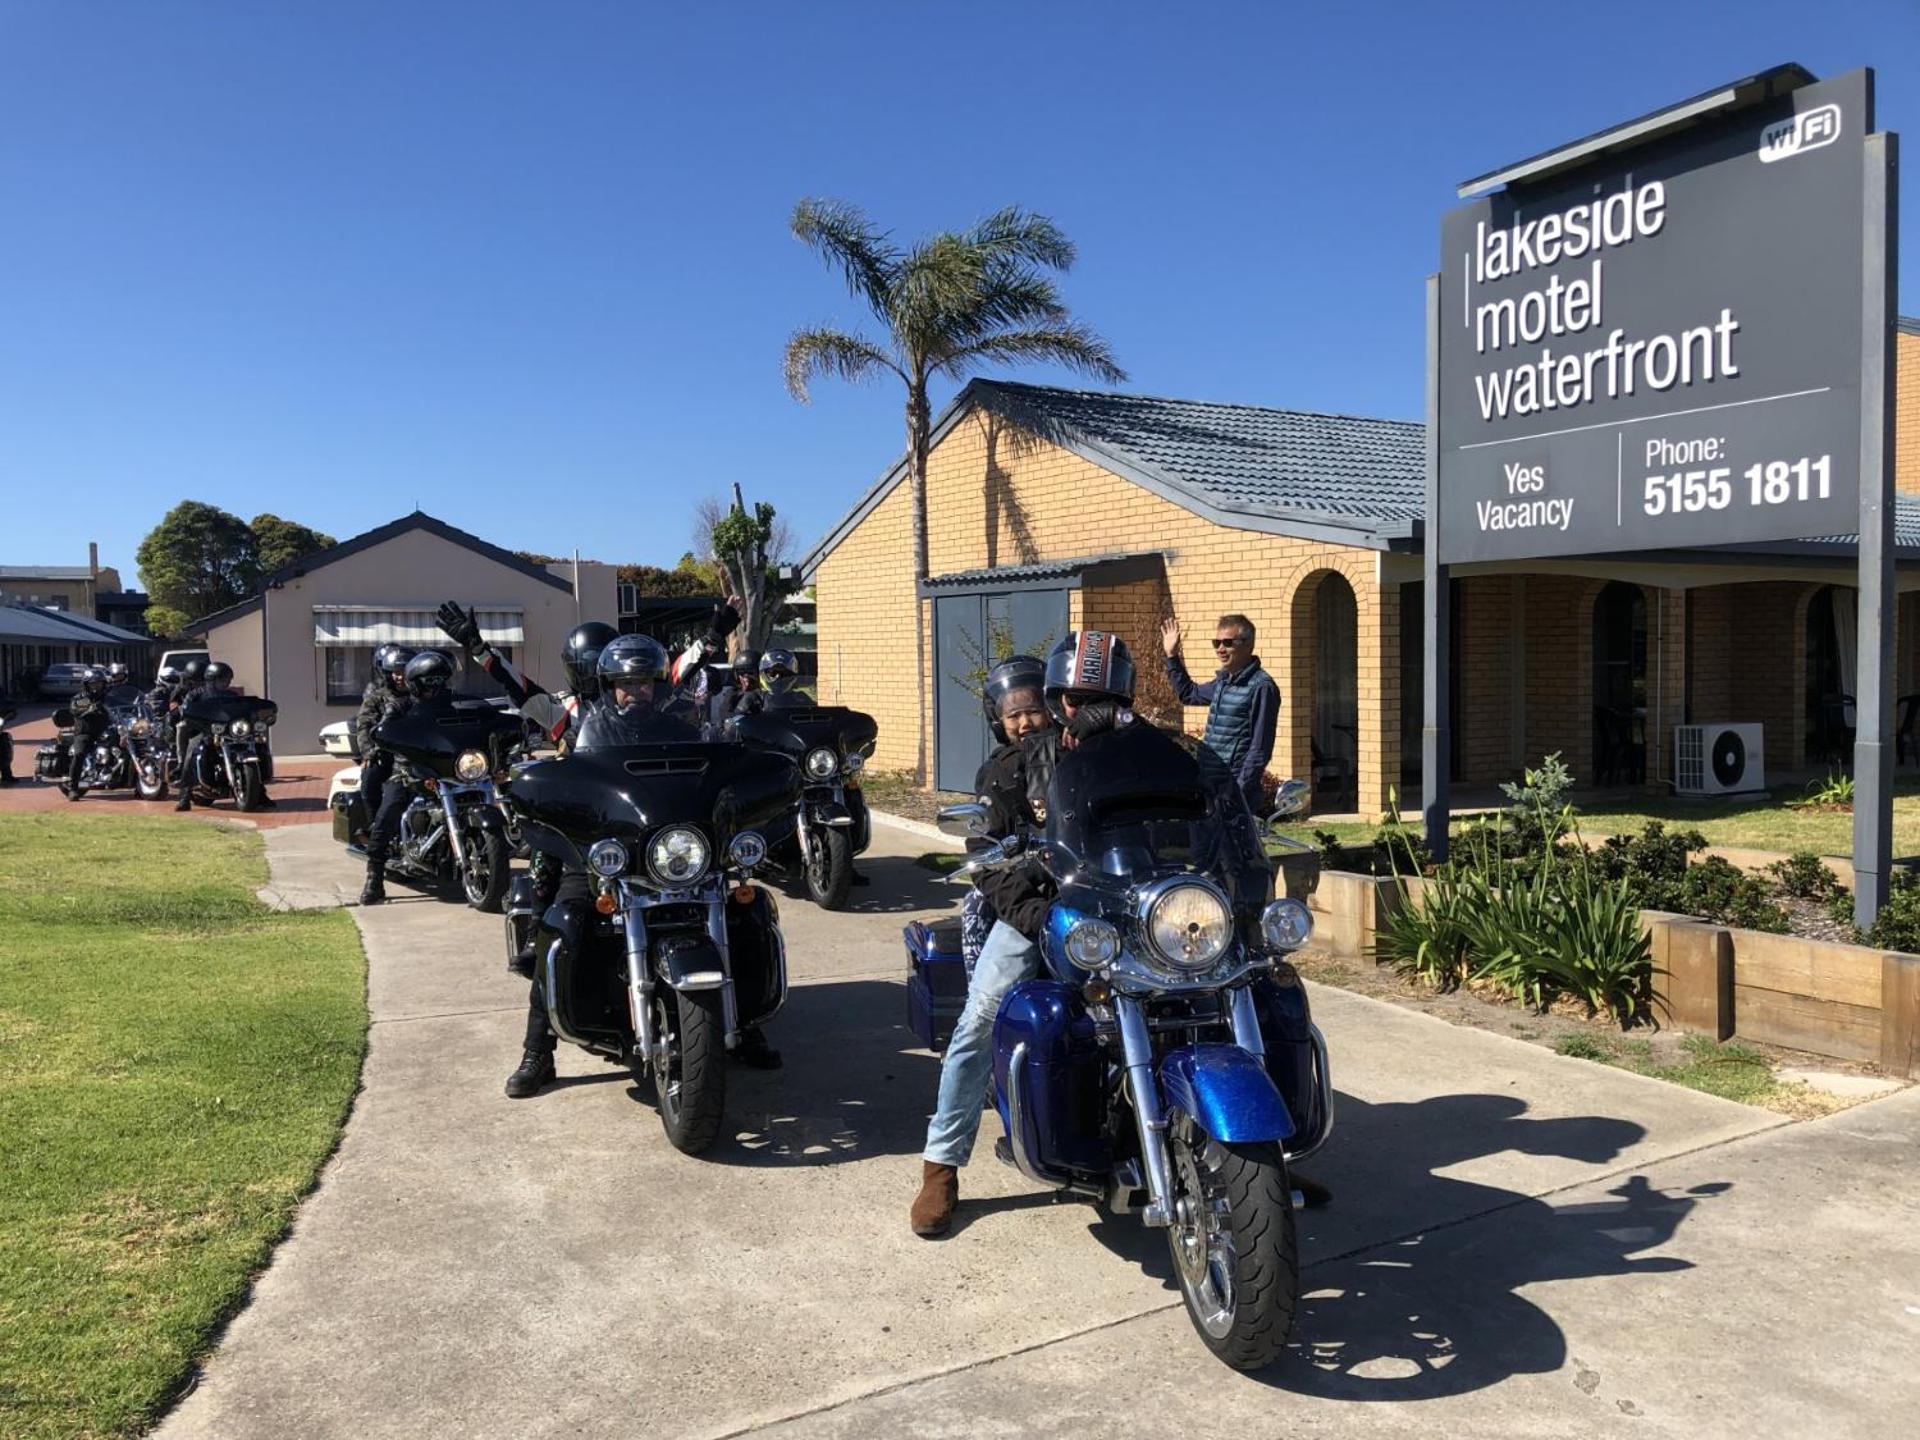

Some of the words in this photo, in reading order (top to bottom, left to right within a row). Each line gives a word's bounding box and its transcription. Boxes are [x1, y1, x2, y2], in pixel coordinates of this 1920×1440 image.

[1476, 172, 1665, 282] lakeside
[1476, 258, 1602, 352] motel
[1475, 308, 1739, 420] waterfront
[1504, 462, 1545, 494] Yes
[1646, 436, 1725, 468] Phone:
[1476, 498, 1574, 531] Vacancy
[1644, 467, 1732, 515] 5155
[1744, 454, 1831, 505] 1811
